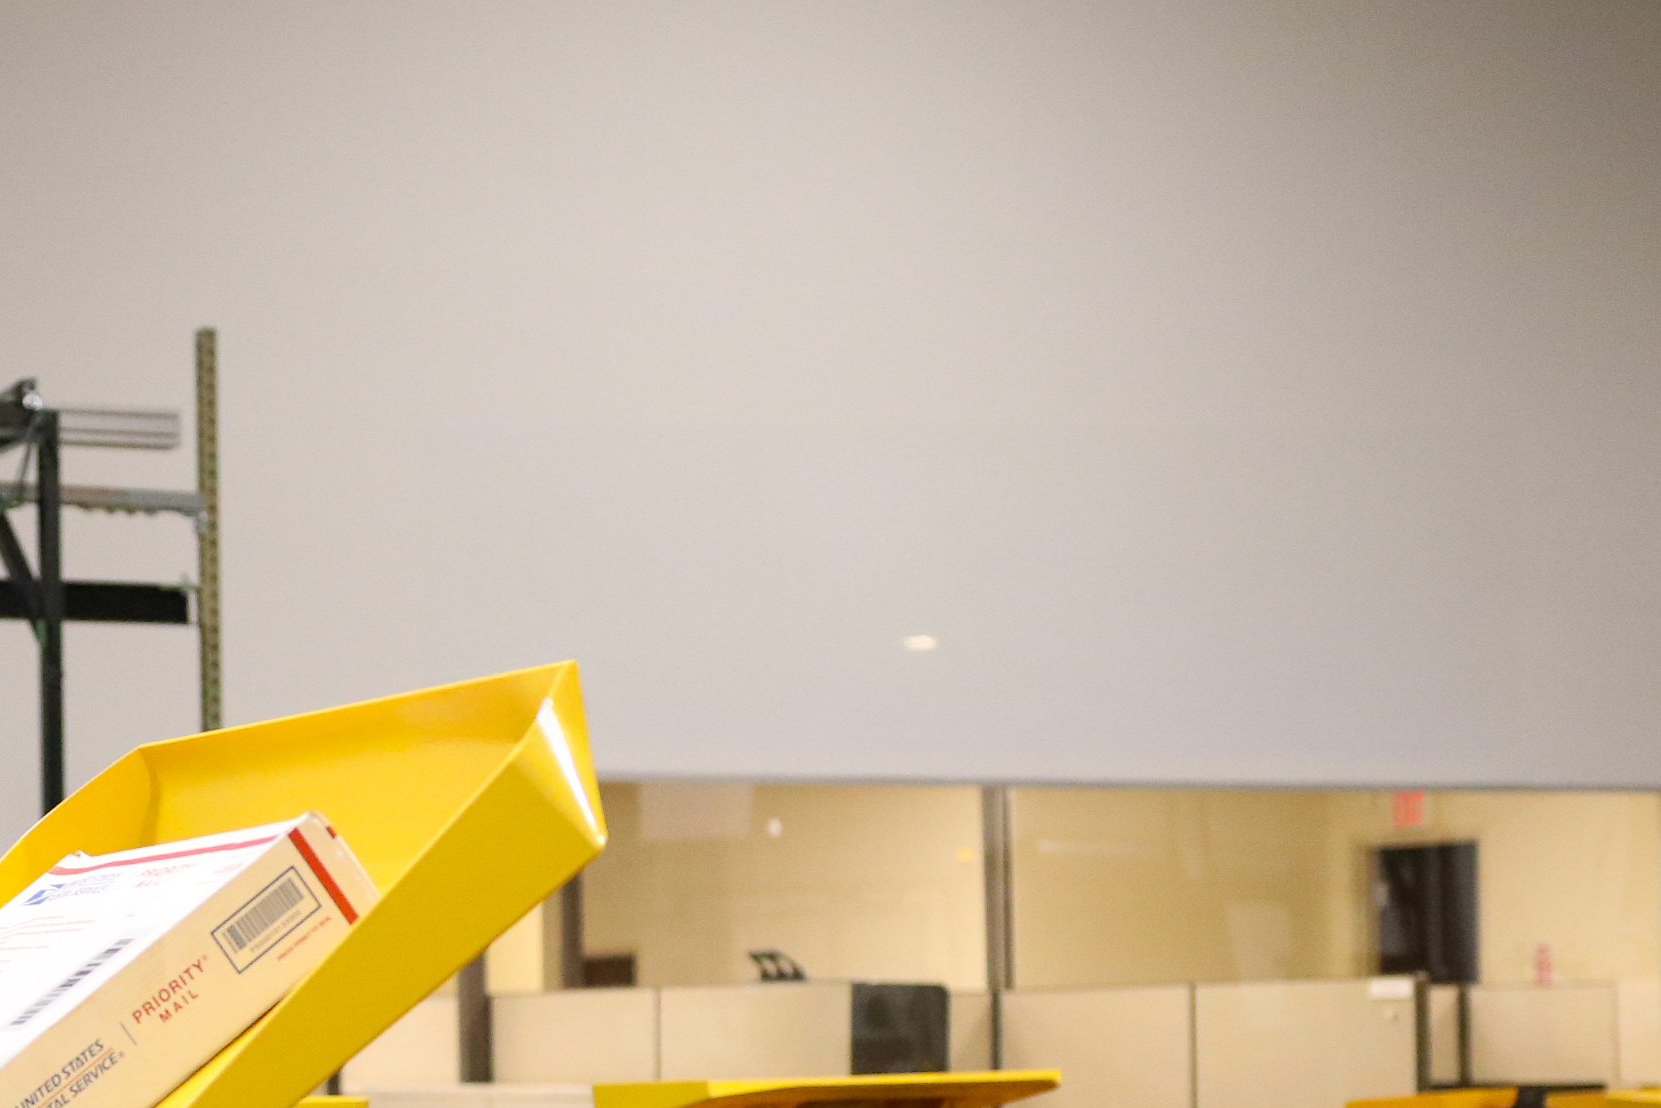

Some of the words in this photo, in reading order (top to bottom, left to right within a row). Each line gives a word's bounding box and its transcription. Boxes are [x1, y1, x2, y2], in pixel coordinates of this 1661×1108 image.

[131, 958, 205, 1024] PRIORITY
[159, 989, 199, 1023] MAIL
[61, 1038, 105, 1081] STATES
[68, 1051, 119, 1099] SERVICE
